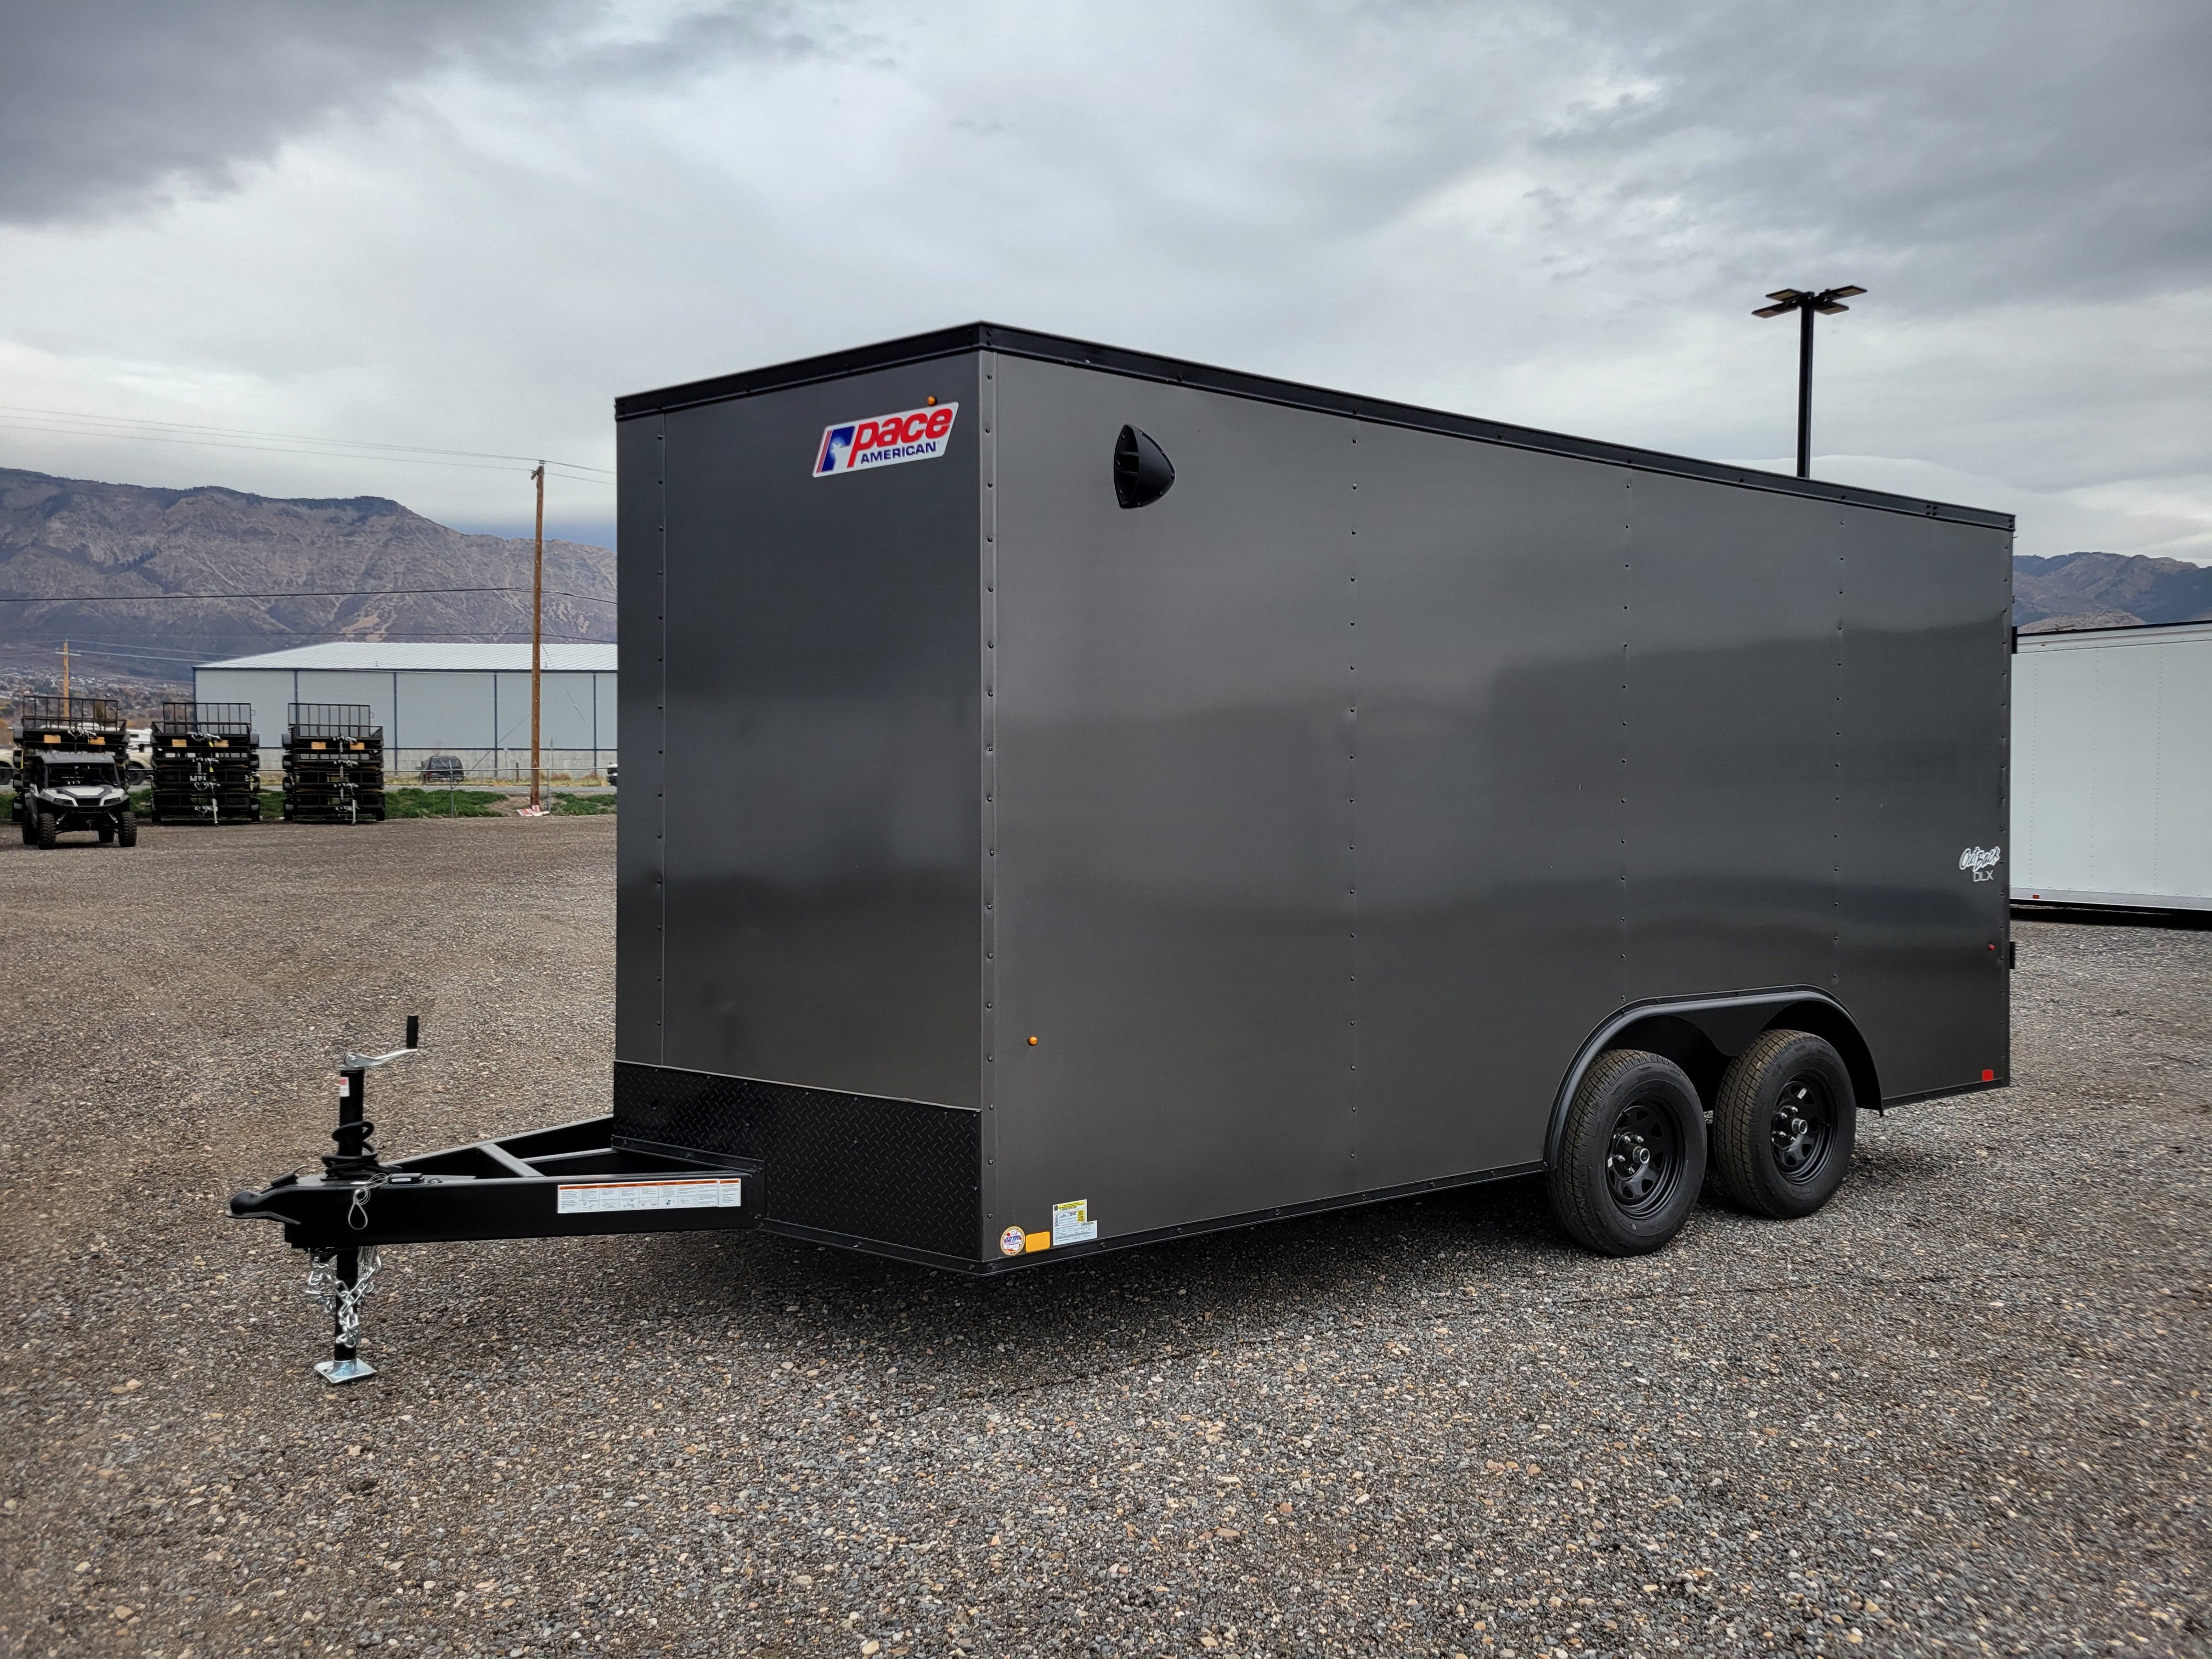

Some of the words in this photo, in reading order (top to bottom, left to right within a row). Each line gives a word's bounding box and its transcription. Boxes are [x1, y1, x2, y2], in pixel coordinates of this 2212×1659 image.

[847, 408, 953, 469] pace
[861, 442, 936, 464] AMERICAN
[1973, 870, 1994, 882] DLX
